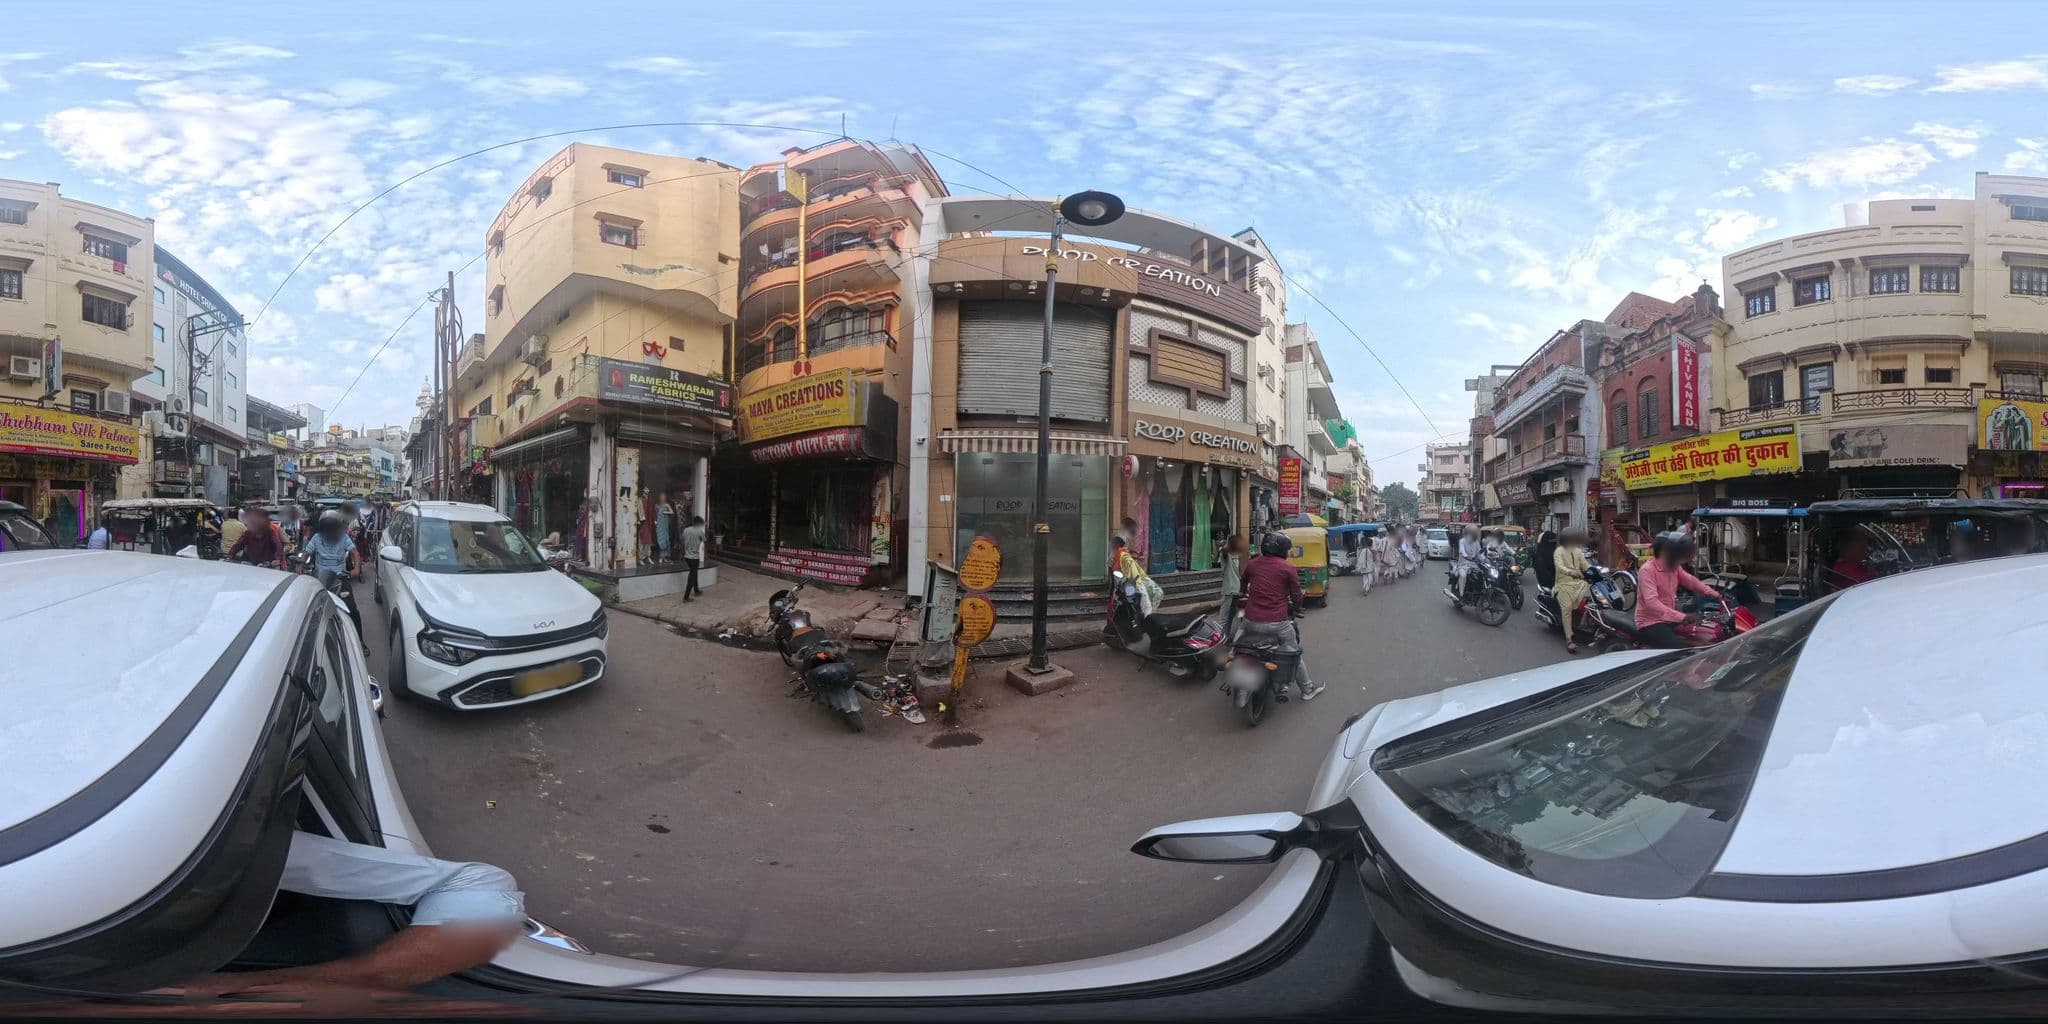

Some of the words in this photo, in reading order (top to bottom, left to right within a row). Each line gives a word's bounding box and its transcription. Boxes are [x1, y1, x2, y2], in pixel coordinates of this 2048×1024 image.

[180, 280, 199, 299] HOTEL
[1677, 337, 1696, 353] HOTEL
[630, 373, 714, 396] RAMESHWARAM
[651, 386, 697, 400] FABRICS
[1684, 349, 1693, 426] SHIVANAND
[749, 398, 774, 418] MAYA
[776, 379, 844, 411] CREATIONS
[71, 421, 96, 438] Silk
[100, 425, 135, 444] Palace
[1135, 420, 1185, 444] ROOP
[1190, 431, 1258, 454] CREATION
[80, 440, 103, 450] Saree
[106, 443, 133, 455] Factory
[752, 442, 794, 461] FACTORY
[796, 433, 846, 455] OUTLET
[1624, 460, 1651, 479] अंग्रेजी
[1653, 457, 1669, 473] एवं
[1669, 453, 1688, 471] ठंडी
[1689, 450, 1719, 469] बियर
[1721, 443, 1742, 464] की
[1744, 441, 1789, 468] दुकान
